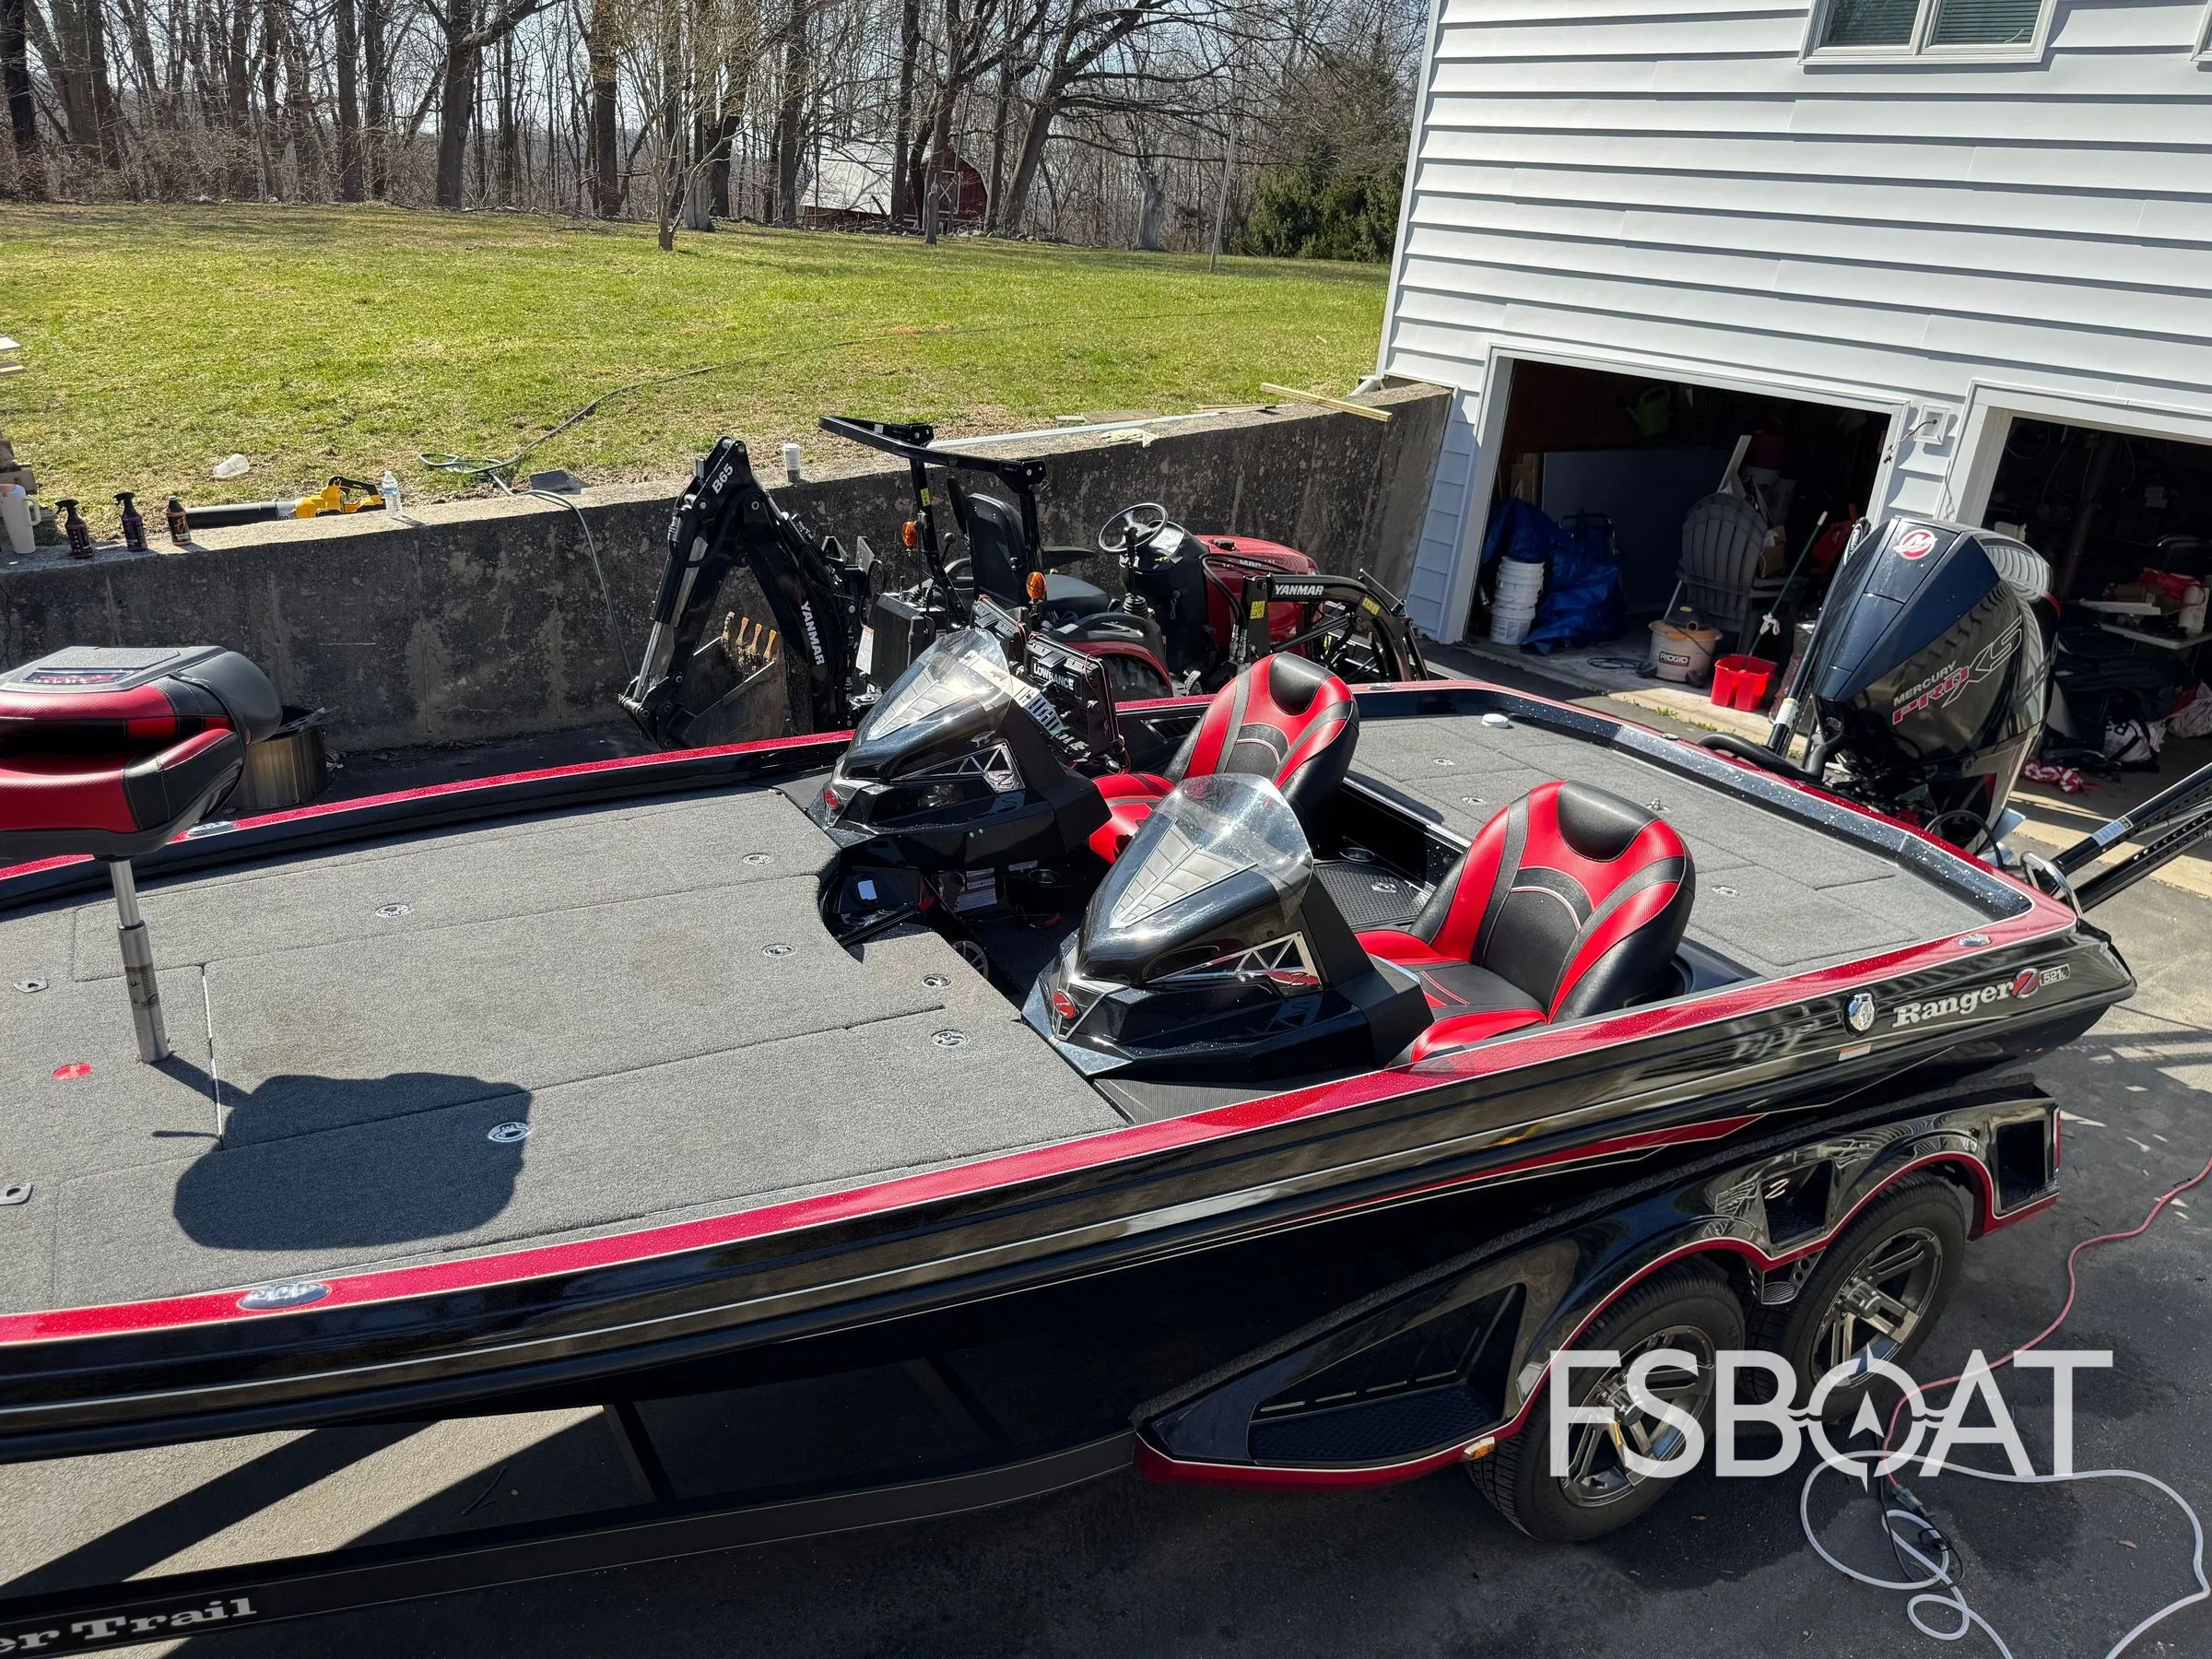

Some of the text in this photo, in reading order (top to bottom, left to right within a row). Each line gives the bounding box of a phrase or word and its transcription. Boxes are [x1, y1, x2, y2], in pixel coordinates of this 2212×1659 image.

[711, 463, 735, 495] B65
[1275, 583, 1324, 596] YANMAR
[800, 600, 826, 666] YANMAR
[1033, 662, 1076, 691] LOWRANCE
[1660, 652, 1688, 664] RIDGID
[1892, 665, 1971, 726] PRO
[1893, 660, 1958, 707] MERCURY
[1891, 981, 2015, 1029] Ranger
[71, 1597, 257, 1640] Trail
